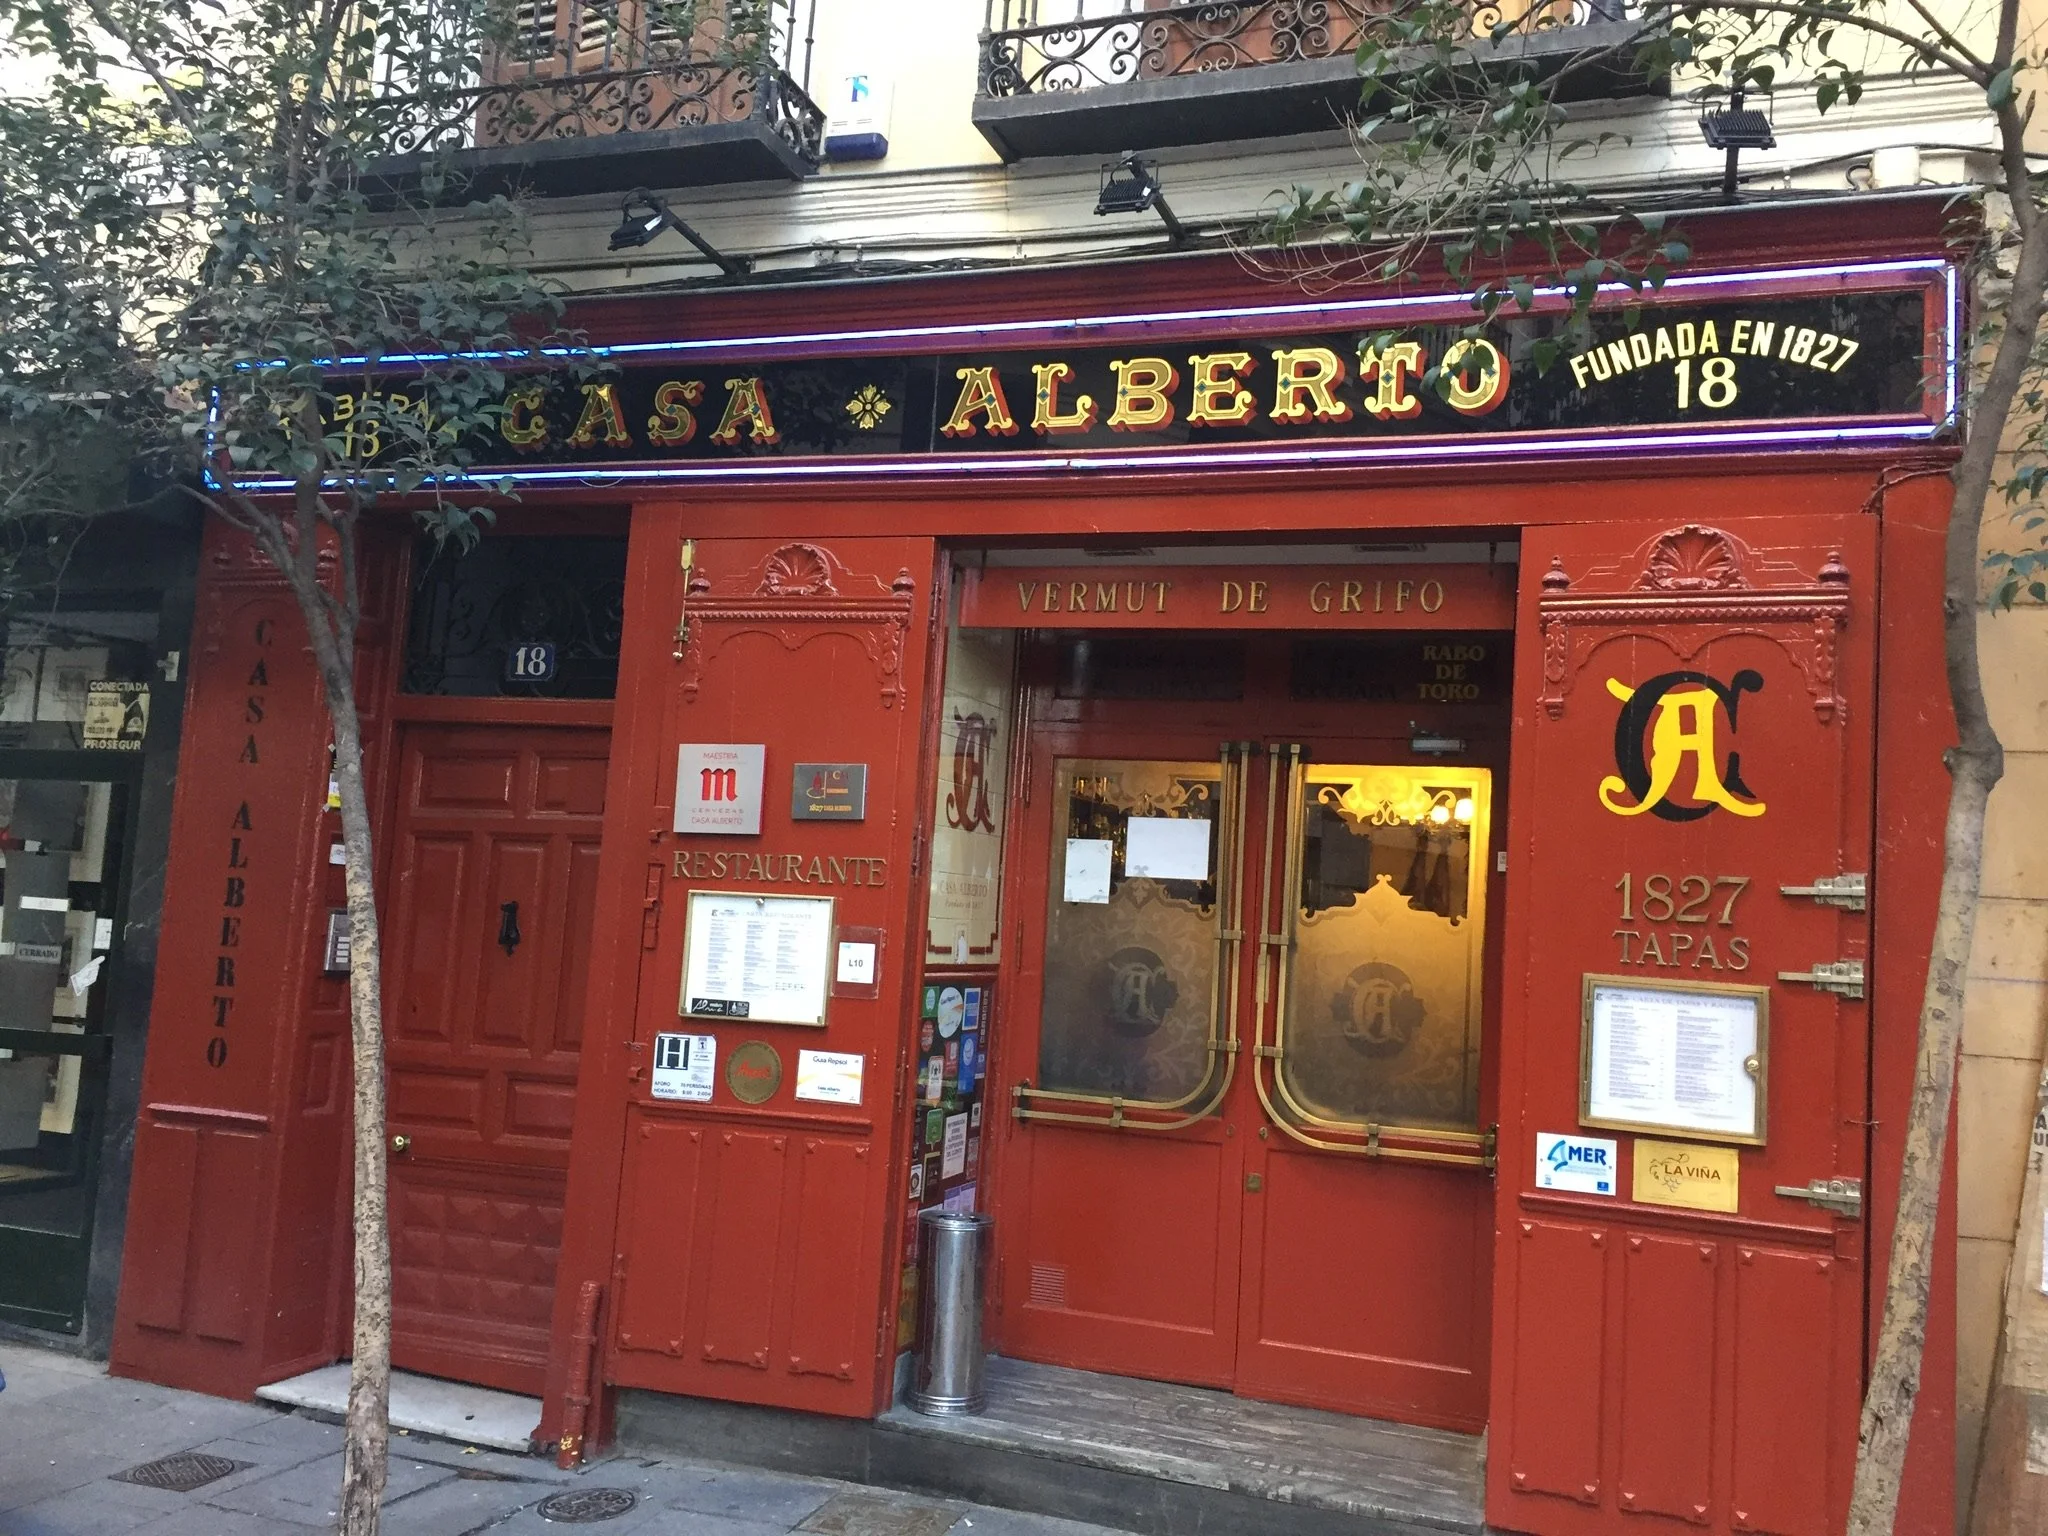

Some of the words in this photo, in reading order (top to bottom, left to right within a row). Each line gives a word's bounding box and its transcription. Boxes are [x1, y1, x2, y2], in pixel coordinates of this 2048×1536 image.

[1569, 320, 1720, 389] FUNDADA
[1730, 319, 1776, 356] EN
[1779, 325, 1859, 373] 1827
[499, 376, 778, 455] CASA
[940, 338, 1510, 438] ALBERTO
[1674, 357, 1738, 409] 18
[1017, 581, 1172, 613] VERMUT
[1221, 580, 1269, 613] DE
[1310, 580, 1445, 613] GRIFO
[515, 646, 547, 676] 18
[1423, 645, 1485, 661] RABO
[89, 681, 149, 692] CONECTADA
[1435, 664, 1466, 680] DE
[1417, 683, 1480, 700] TORO
[83, 739, 141, 750] PROSEGUR
[671, 850, 888, 887] RESTAURANTE
[1615, 872, 1751, 925] 1827
[206, 800, 252, 1068] ALBERTO
[848, 959, 864, 968] L10
[1612, 929, 1749, 970] TAPAS
[827, 1057, 848, 1065] Repsol
[1664, 1164, 1683, 1177] LA
[1686, 1166, 1721, 1180] VIÑA
